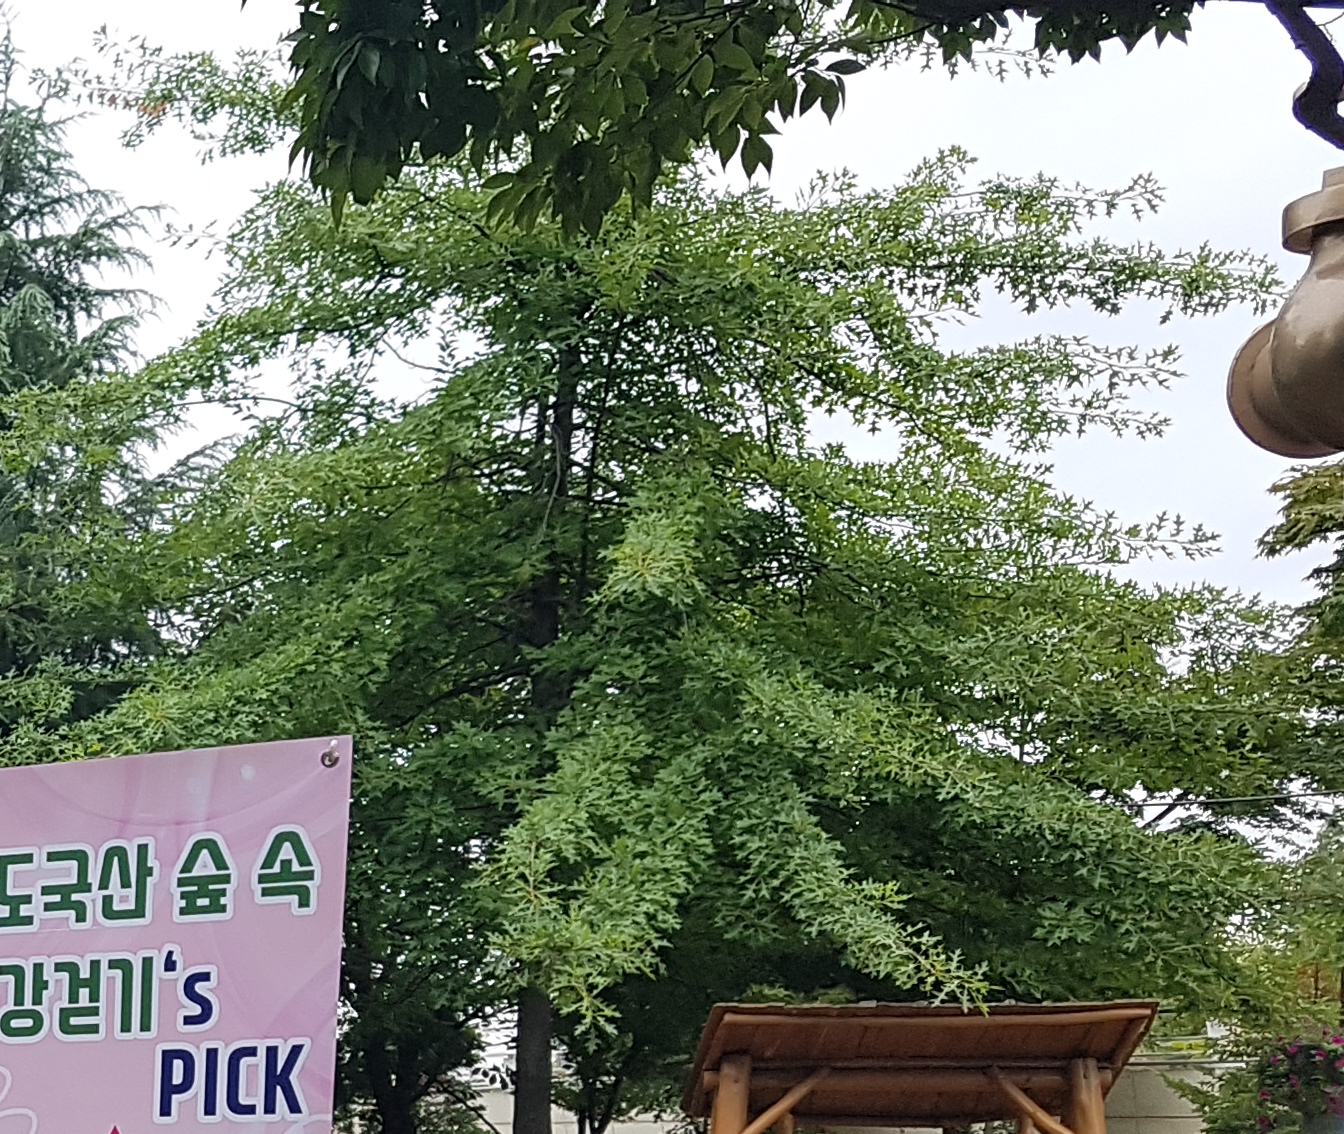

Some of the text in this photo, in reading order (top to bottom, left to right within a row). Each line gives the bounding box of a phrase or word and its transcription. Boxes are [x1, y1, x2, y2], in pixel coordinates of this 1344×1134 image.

[177, 838, 231, 916] 숲
[258, 831, 315, 908] 속
[159, 1043, 305, 1118] PICK
